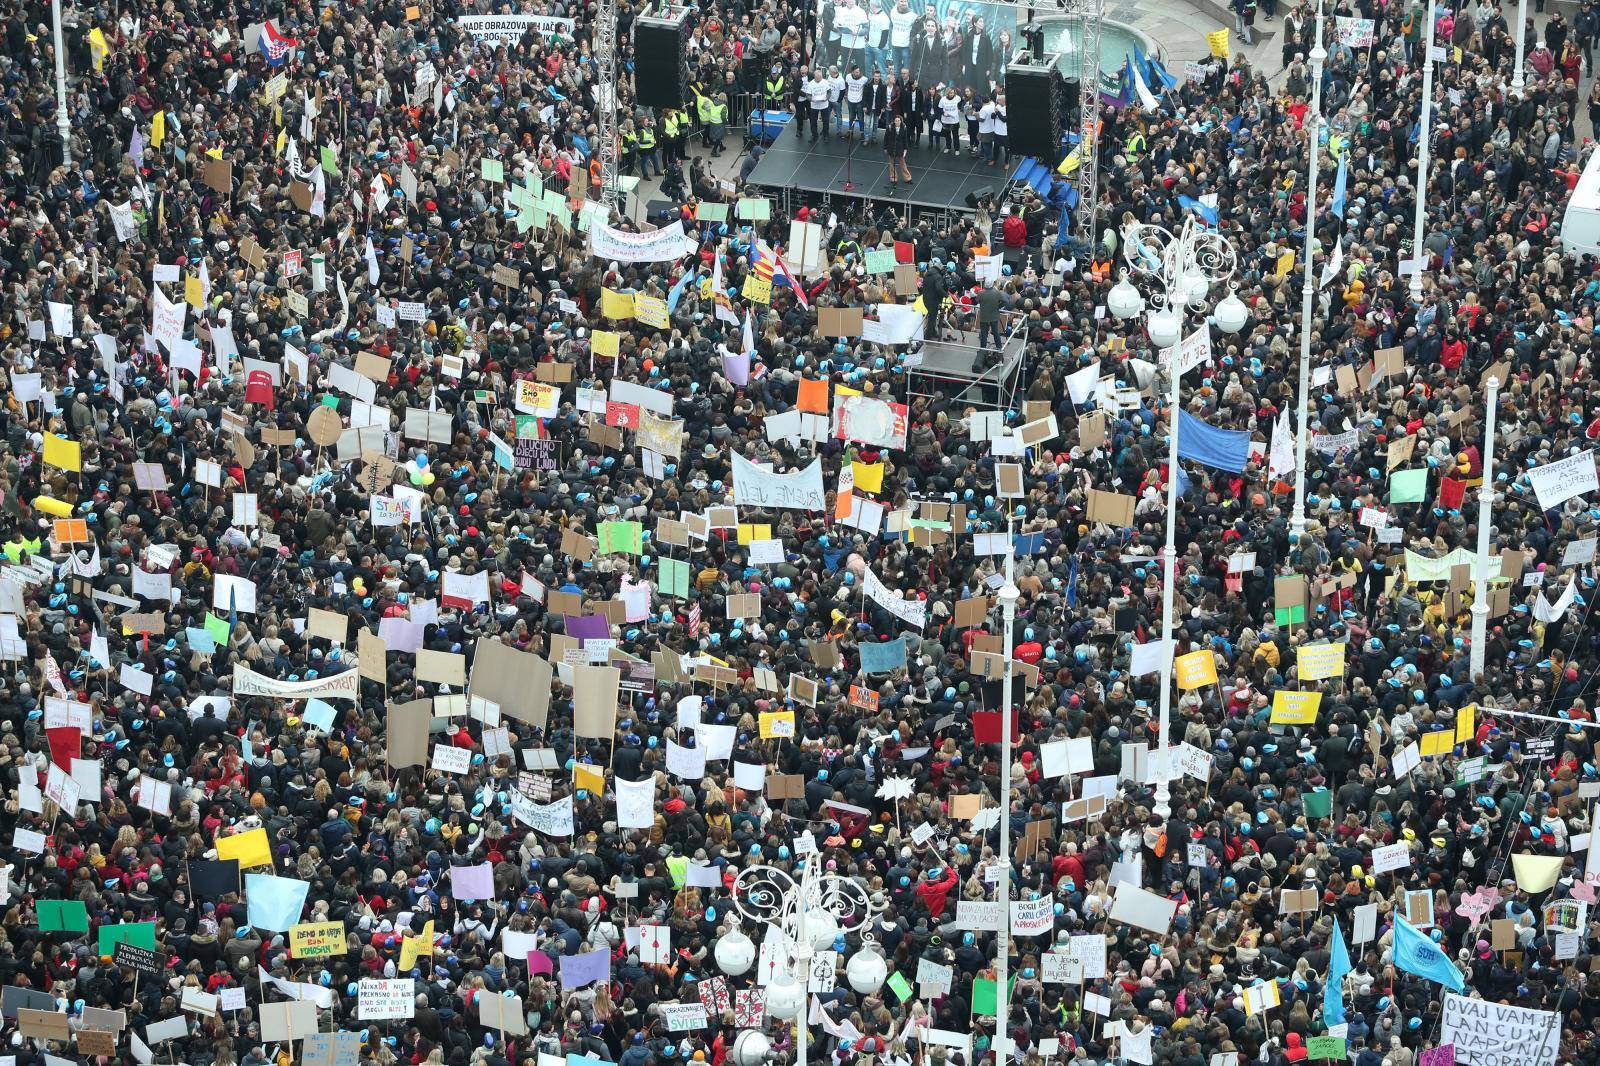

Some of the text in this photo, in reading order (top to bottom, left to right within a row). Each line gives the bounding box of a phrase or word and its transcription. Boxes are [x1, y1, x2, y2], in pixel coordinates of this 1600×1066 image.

[464, 22, 483, 31] NADE
[523, 382, 552, 392] ZAJEDNO
[522, 389, 538, 397] SMO
[516, 448, 537, 458] DJECU
[514, 457, 556, 470] BUDU LJUDI
[1018, 903, 1036, 911] BOGU
[1018, 911, 1034, 920] CARU
[1014, 920, 1019, 928] A
[300, 944, 331, 956] PONOSAN
[1447, 998, 1558, 1029] OVAJ VAM JE
[671, 1018, 705, 1029] SVIJET
[1453, 1030, 1554, 1058] NAPUNIO
